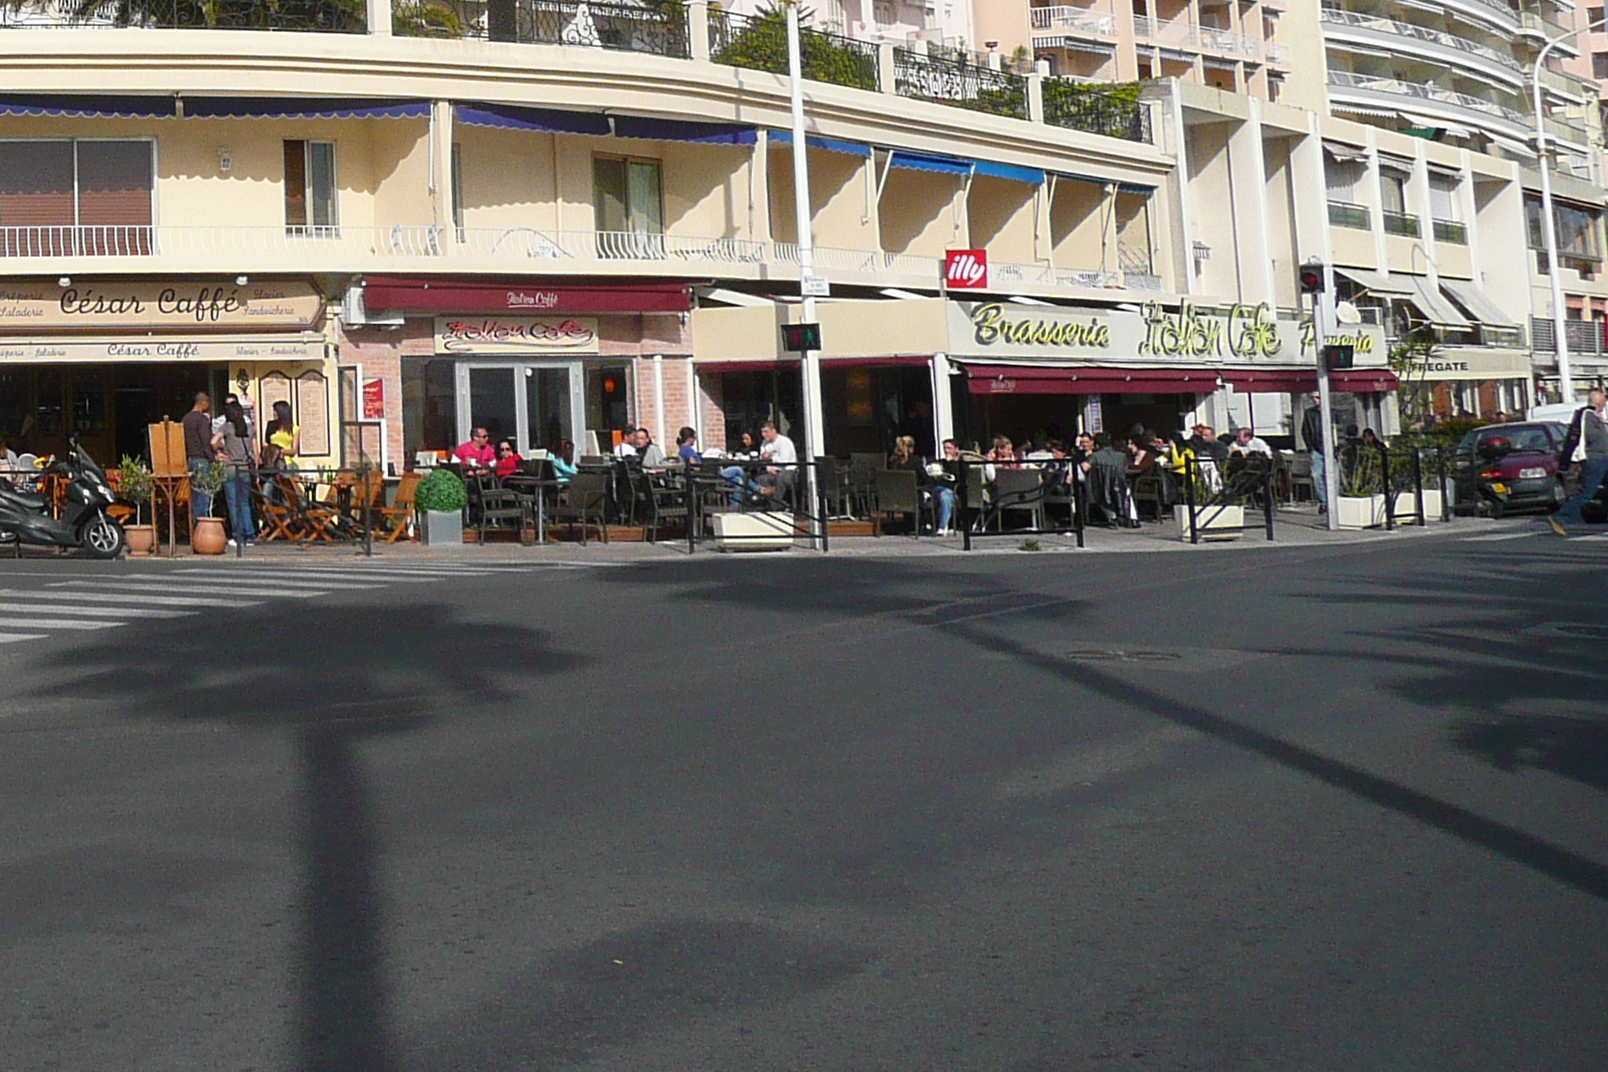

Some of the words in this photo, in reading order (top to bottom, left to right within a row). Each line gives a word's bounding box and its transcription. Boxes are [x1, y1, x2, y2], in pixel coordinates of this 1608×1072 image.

[947, 254, 986, 286] illy
[59, 288, 146, 315] César
[157, 287, 241, 322] Caffé
[970, 301, 1111, 348] Brasserie
[107, 343, 152, 356] César
[156, 343, 200, 359] Caffé
